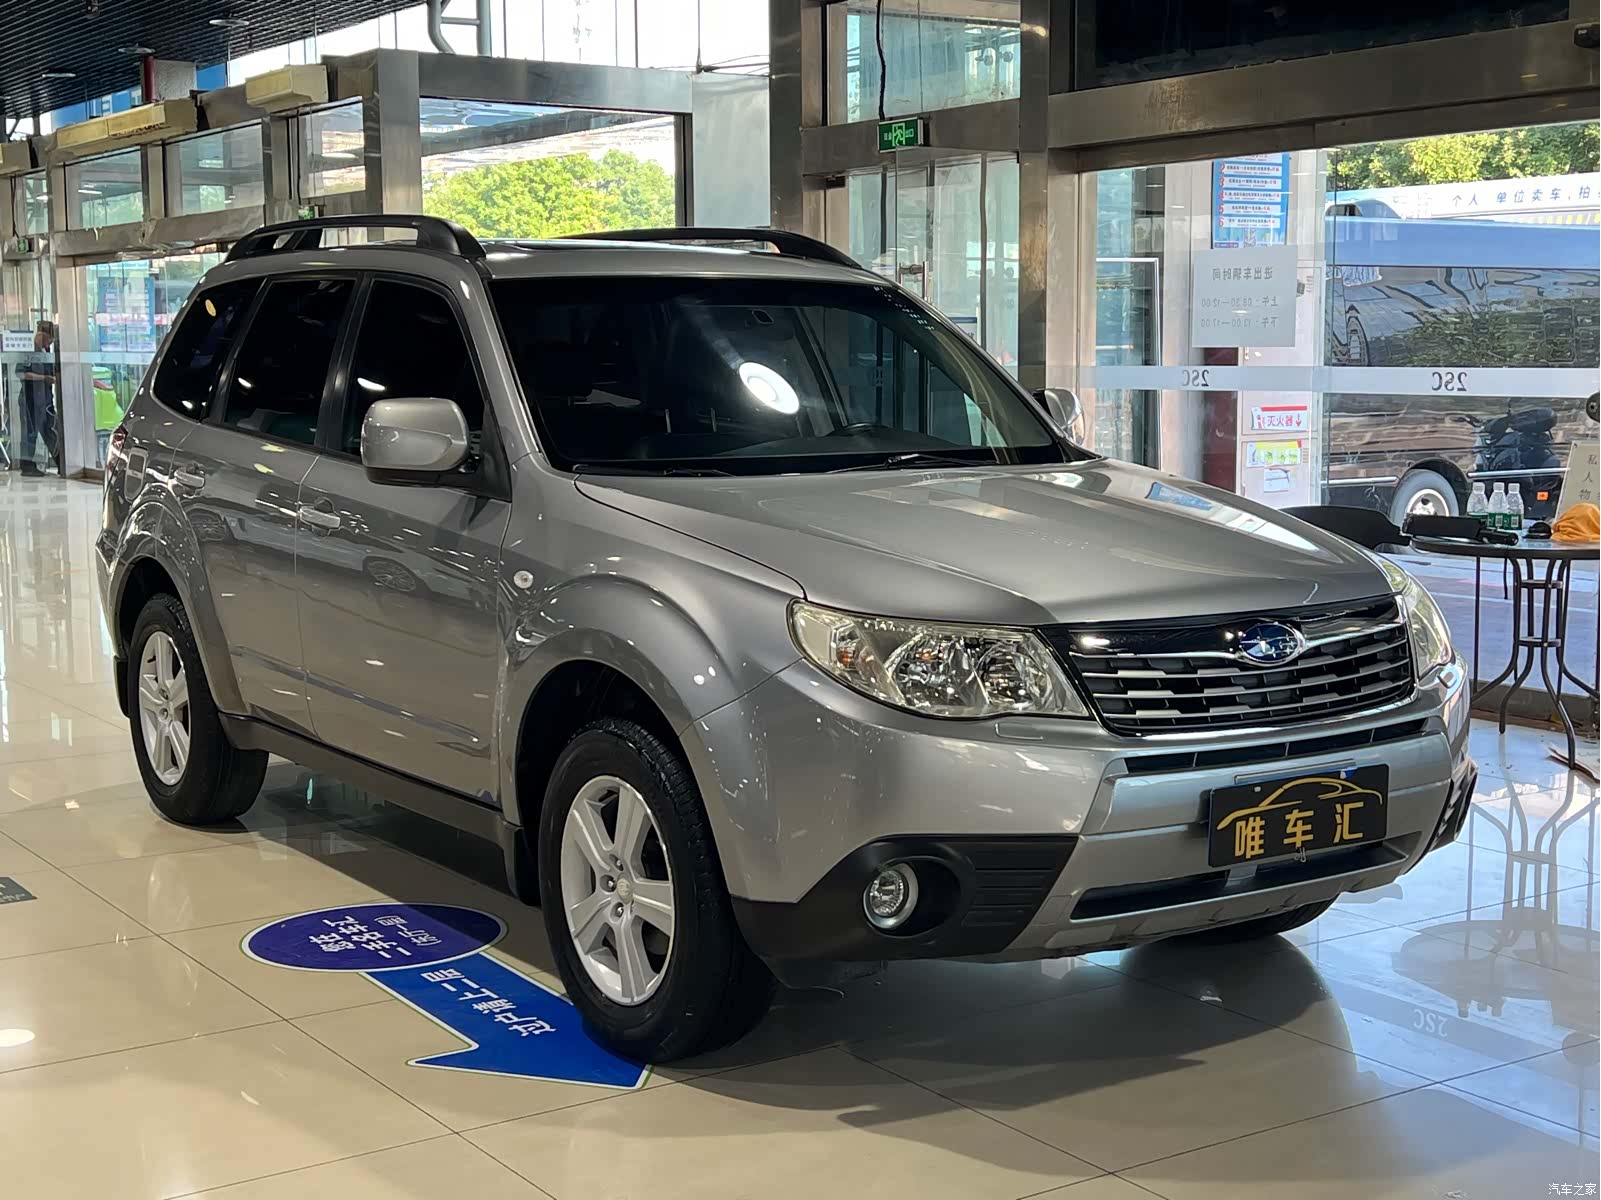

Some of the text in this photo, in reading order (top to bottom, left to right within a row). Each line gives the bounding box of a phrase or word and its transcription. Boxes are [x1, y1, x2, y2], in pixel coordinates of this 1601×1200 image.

[1452, 193, 1478, 207] 个人
[1234, 801, 1364, 859] 唯车汇
[308, 932, 357, 953] 您在
[322, 916, 411, 959] 二手名车汇
[421, 968, 556, 1037] 过户请上二层
